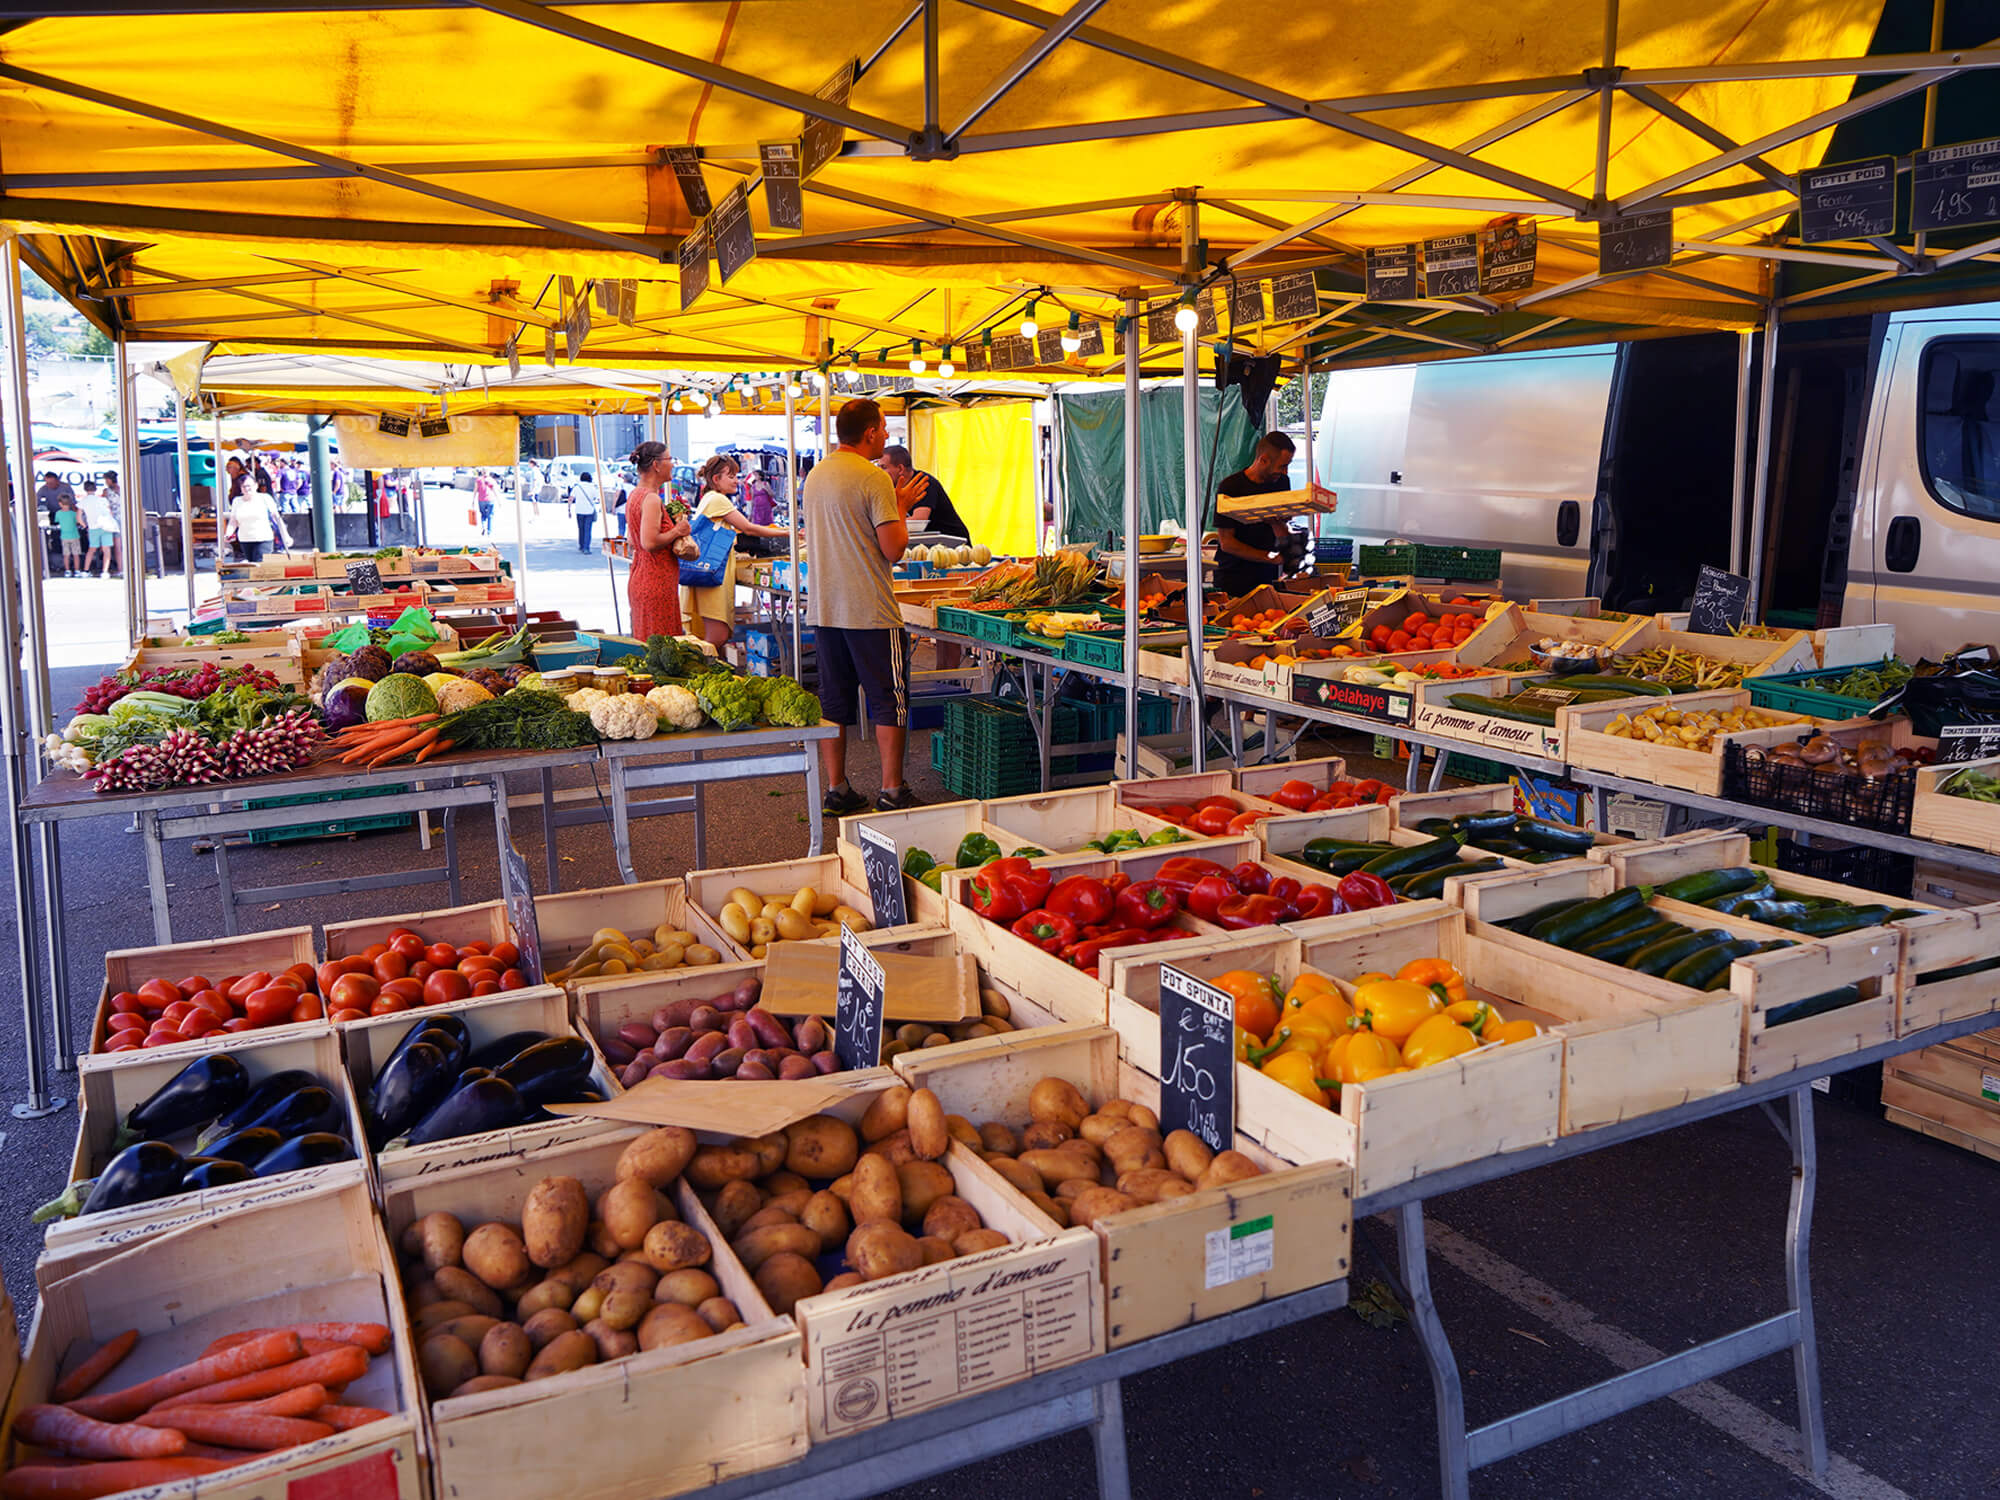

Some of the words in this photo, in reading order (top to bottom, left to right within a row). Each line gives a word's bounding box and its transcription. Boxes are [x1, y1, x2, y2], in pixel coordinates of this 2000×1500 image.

[1811, 174, 1851, 188] PETIT
[1855, 167, 1884, 181] POIS
[1434, 237, 1466, 248] TOMATE
[1328, 684, 1385, 713] Delahaye
[1418, 707, 1433, 722] la
[1431, 714, 1475, 730] pomme
[1478, 720, 1534, 743] d'amour
[841, 928, 858, 957] PDT
[862, 951, 885, 988] ROSE
[847, 955, 874, 998] CHERIE
[1162, 970, 1183, 989] PDT
[1186, 982, 1231, 1017] SPUNTA
[1178, 1007, 1199, 1032] €
[1161, 1034, 1216, 1101] 1.50
[846, 1309, 873, 1333] la
[878, 1286, 966, 1331] pomme
[971, 1258, 1067, 1297] d'amour
